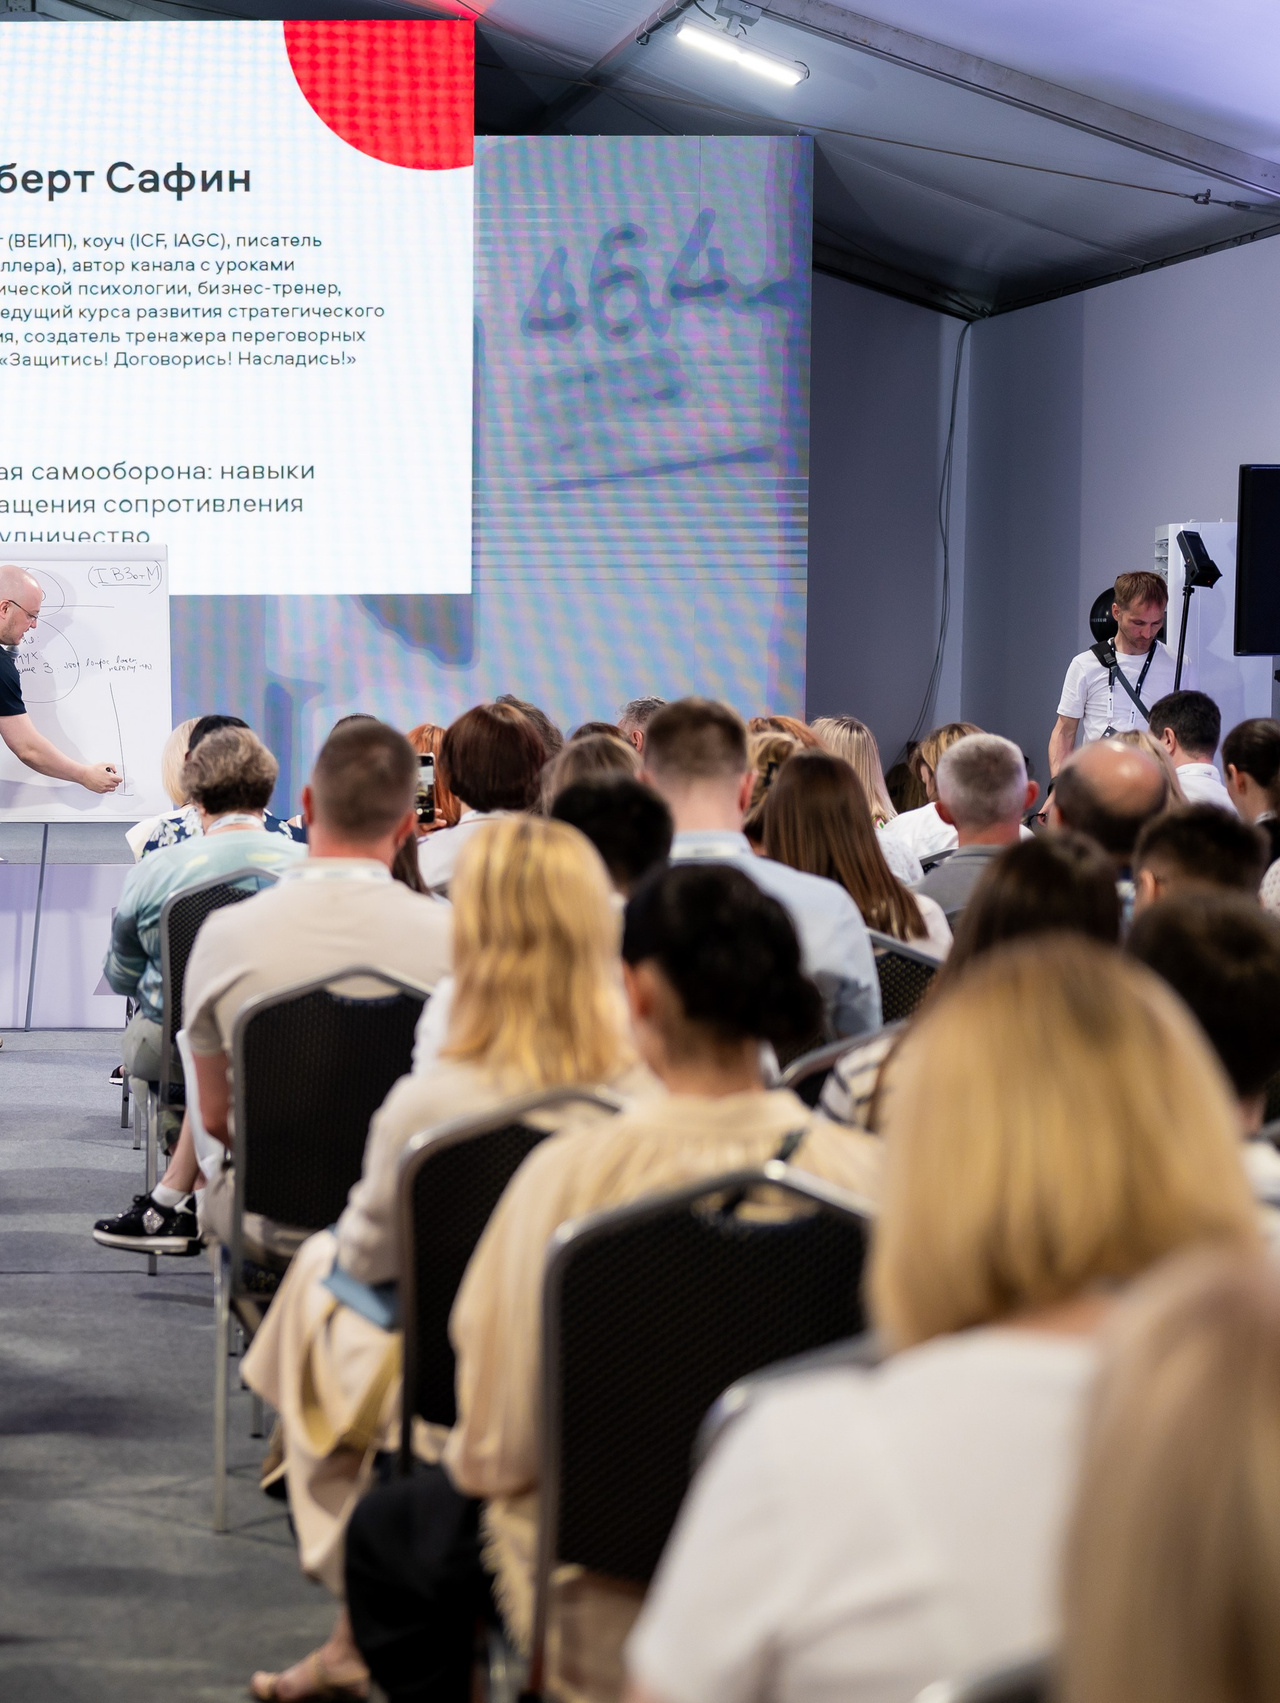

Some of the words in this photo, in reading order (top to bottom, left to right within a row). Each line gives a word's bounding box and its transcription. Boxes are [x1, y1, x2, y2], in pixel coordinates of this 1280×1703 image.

[106, 161, 251, 202] Сафин
[8, 233, 77, 252] (ВЕИП),
[83, 236, 125, 252] коуч
[130, 233, 168, 251] (ICF,
[174, 232, 231, 251] IAGC),
[236, 236, 322, 247] писатель
[72, 260, 125, 276] автор
[131, 260, 195, 272] канала
[200, 260, 210, 272] с
[215, 260, 295, 275] уроками
[78, 284, 192, 297] психологии,
[197, 280, 342, 298] бизнес-тренер,
[78, 307, 131, 323] курса
[136, 307, 222, 322] развития
[227, 306, 385, 322] стратегического
[23, 332, 121, 346] создатель
[125, 331, 226, 346] тренажера
[232, 331, 366, 346] переговорных
[113, 351, 232, 369] Договорись!
[238, 350, 356, 368] Насладись!»
[31, 460, 212, 485] самооборона:
[220, 465, 315, 480] навыки
[103, 498, 303, 518] сопротивления
